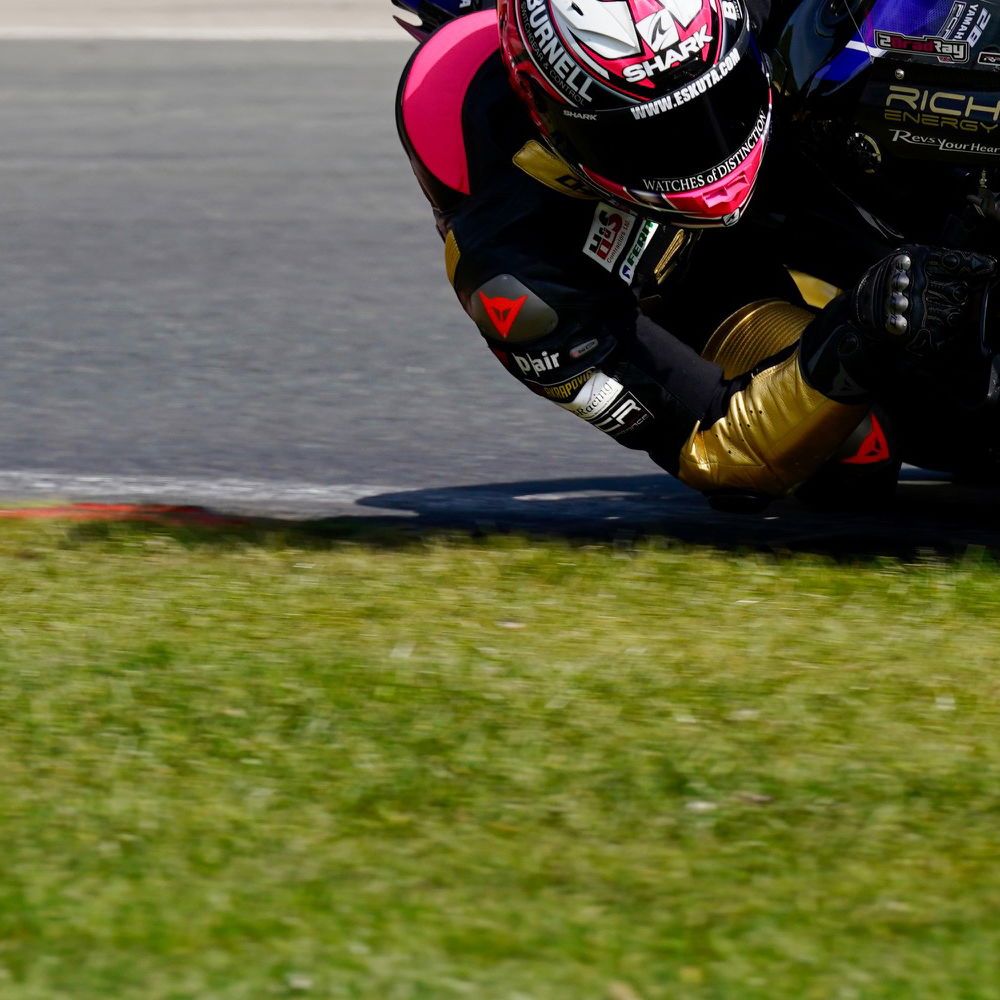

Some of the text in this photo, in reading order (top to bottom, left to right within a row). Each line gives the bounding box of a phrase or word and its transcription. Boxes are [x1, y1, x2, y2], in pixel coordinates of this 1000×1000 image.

[954, 4, 979, 41] YAMAH
[622, 24, 714, 83] SHARK
[549, 68, 585, 106] CONTROL
[630, 47, 741, 120] WWW.ESKUTA.COM
[563, 109, 598, 120] SHARK
[884, 109, 998, 133] ENERGY
[642, 109, 767, 192] WATCHES of DISTINCTION
[888, 128, 935, 143] Revs
[937, 138, 970, 151] Your
